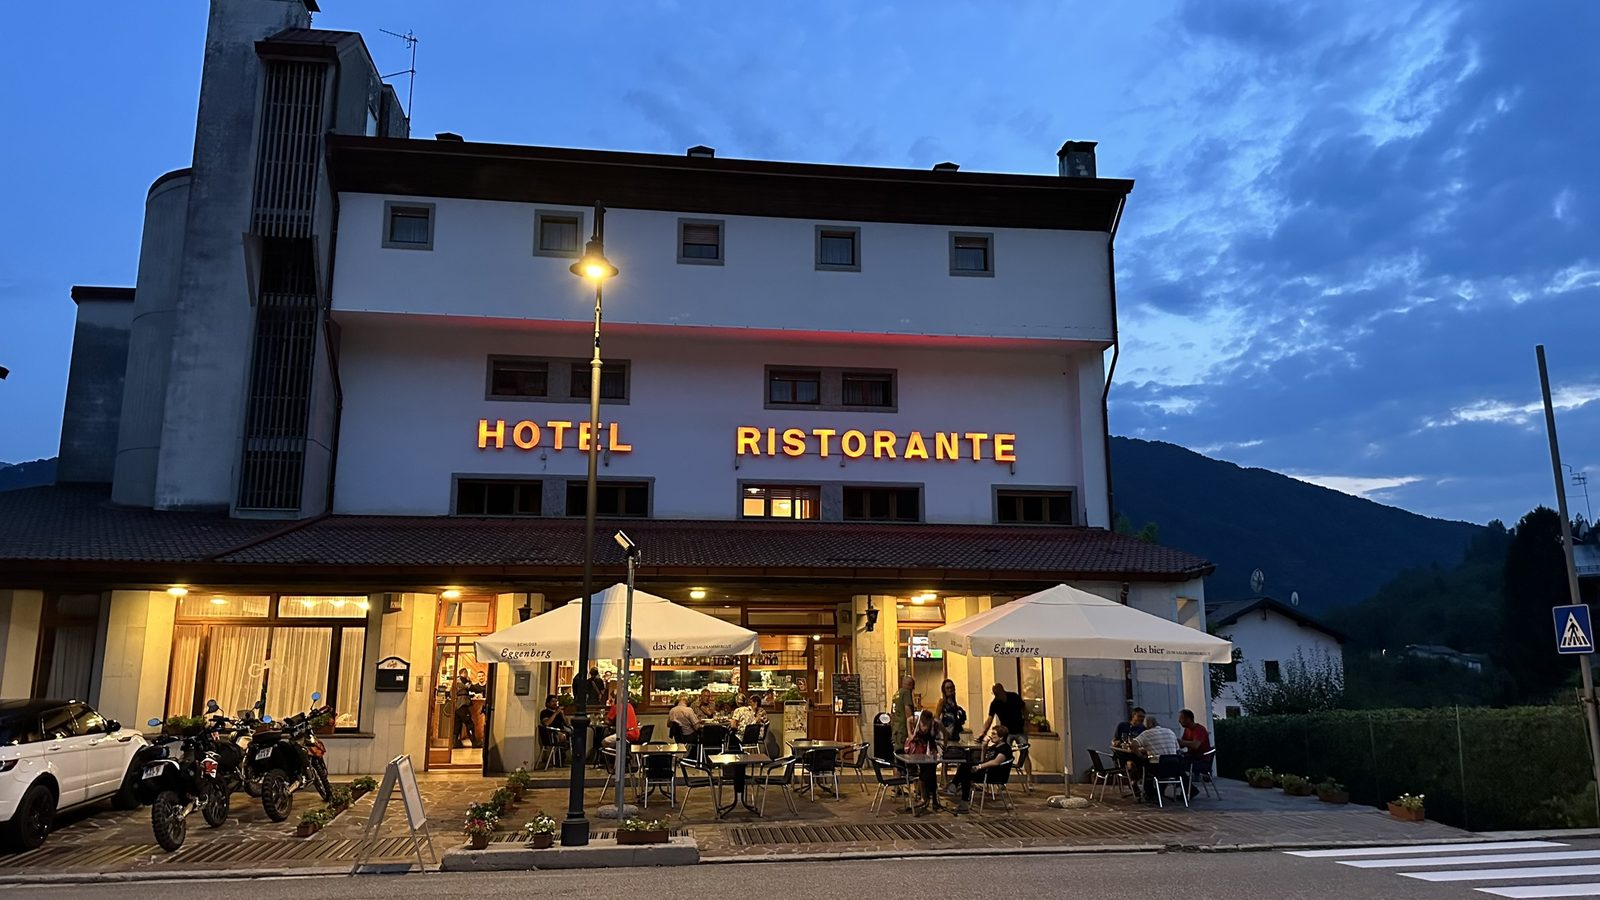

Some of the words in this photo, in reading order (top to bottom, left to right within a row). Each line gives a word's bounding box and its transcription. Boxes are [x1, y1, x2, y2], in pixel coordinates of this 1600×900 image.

[478, 419, 632, 451] HOTEL
[736, 426, 1017, 462] RISTORANTE
[652, 641, 667, 651] das
[668, 641, 685, 651] bier
[993, 643, 1040, 656] Eggenberg
[1133, 644, 1148, 654] das
[1148, 645, 1165, 655] bier
[500, 647, 552, 660] Eggenberg
